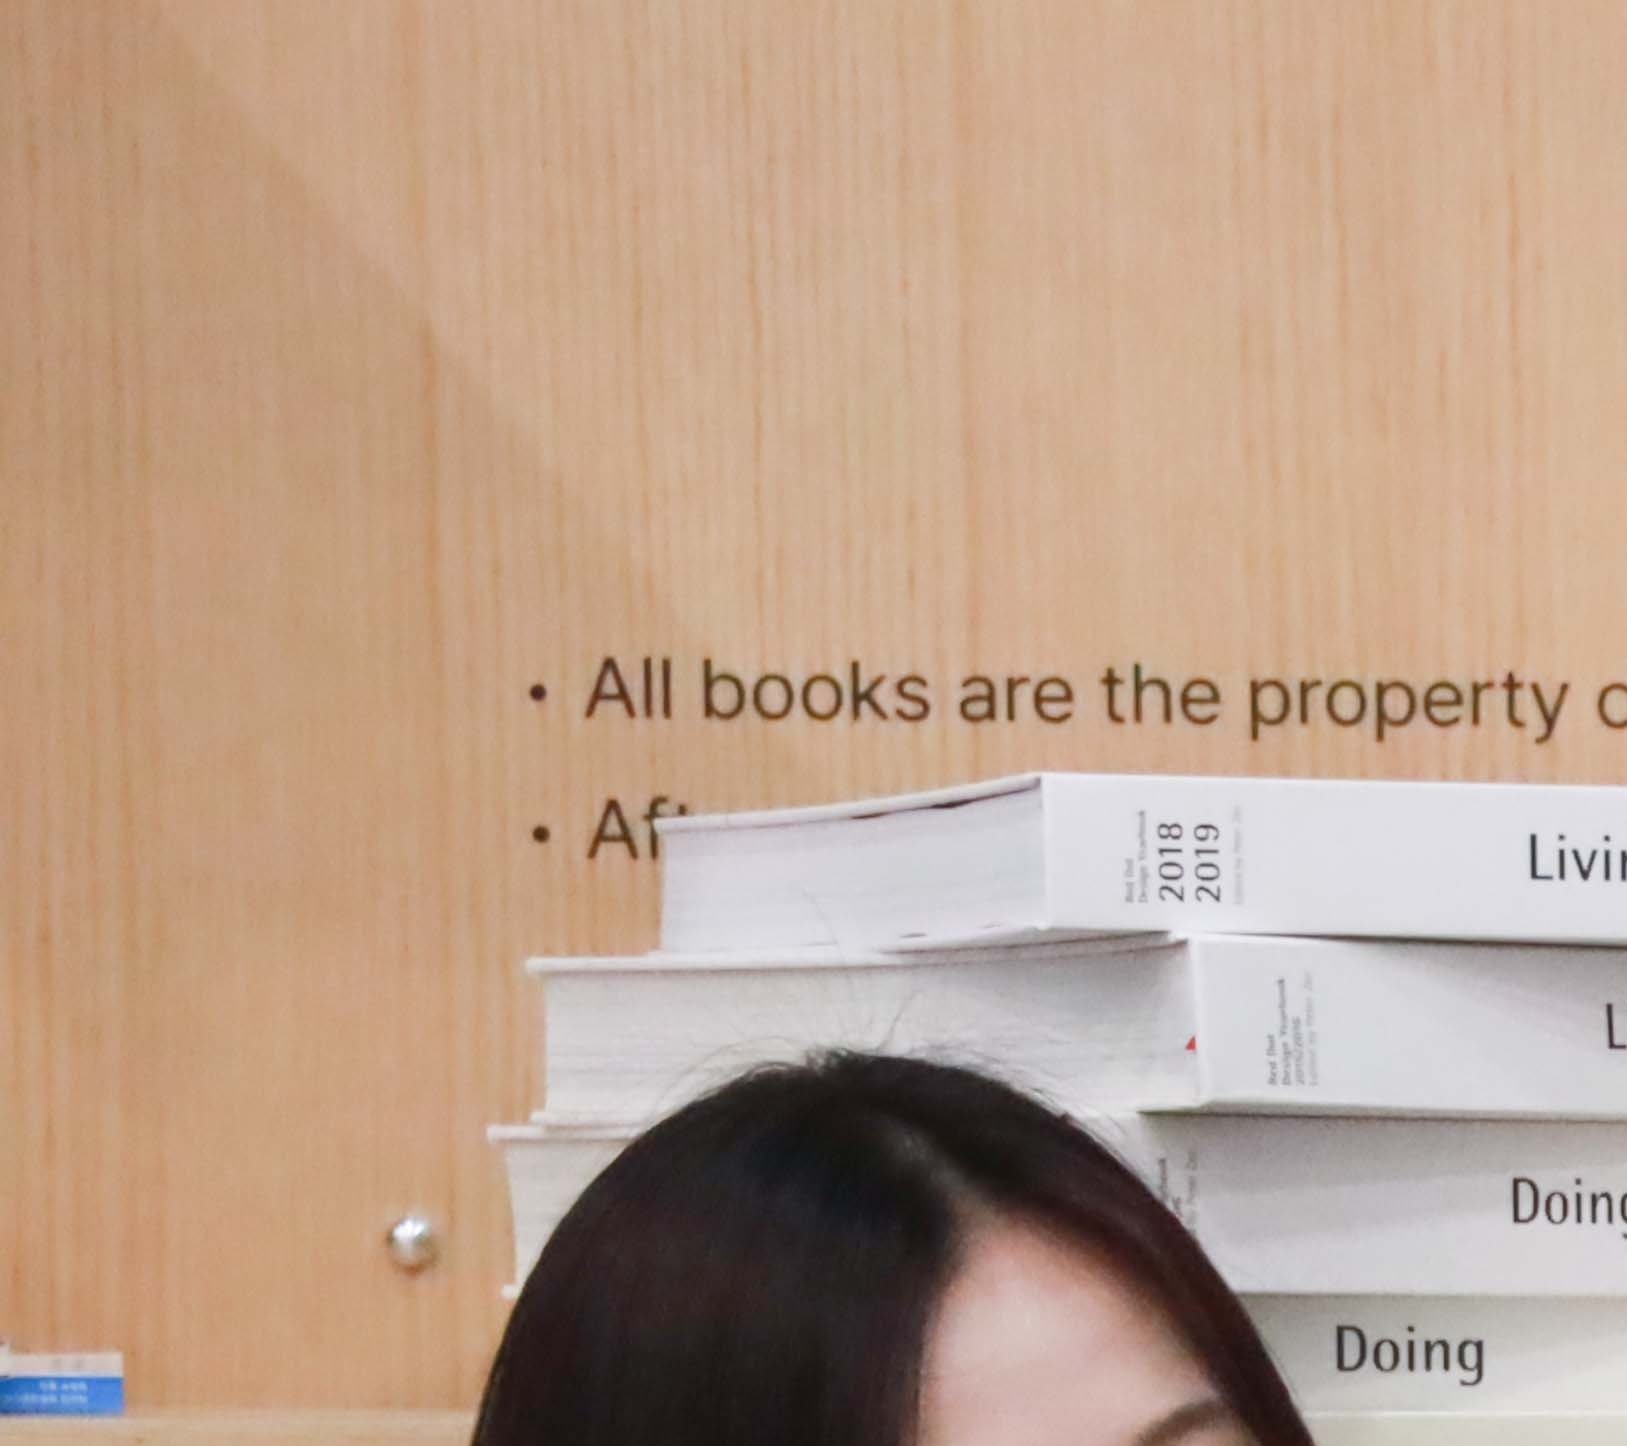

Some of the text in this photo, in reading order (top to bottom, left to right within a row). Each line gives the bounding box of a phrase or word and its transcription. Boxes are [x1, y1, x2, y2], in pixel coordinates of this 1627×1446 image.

[586, 657, 671, 719] All
[703, 658, 930, 722] books
[960, 676, 1073, 723] are
[1101, 664, 1220, 725] the
[1250, 672, 1568, 744] property
[1157, 823, 1184, 903] 2018
[1193, 824, 1221, 903] 2019
[1336, 1325, 1483, 1385] Doing
